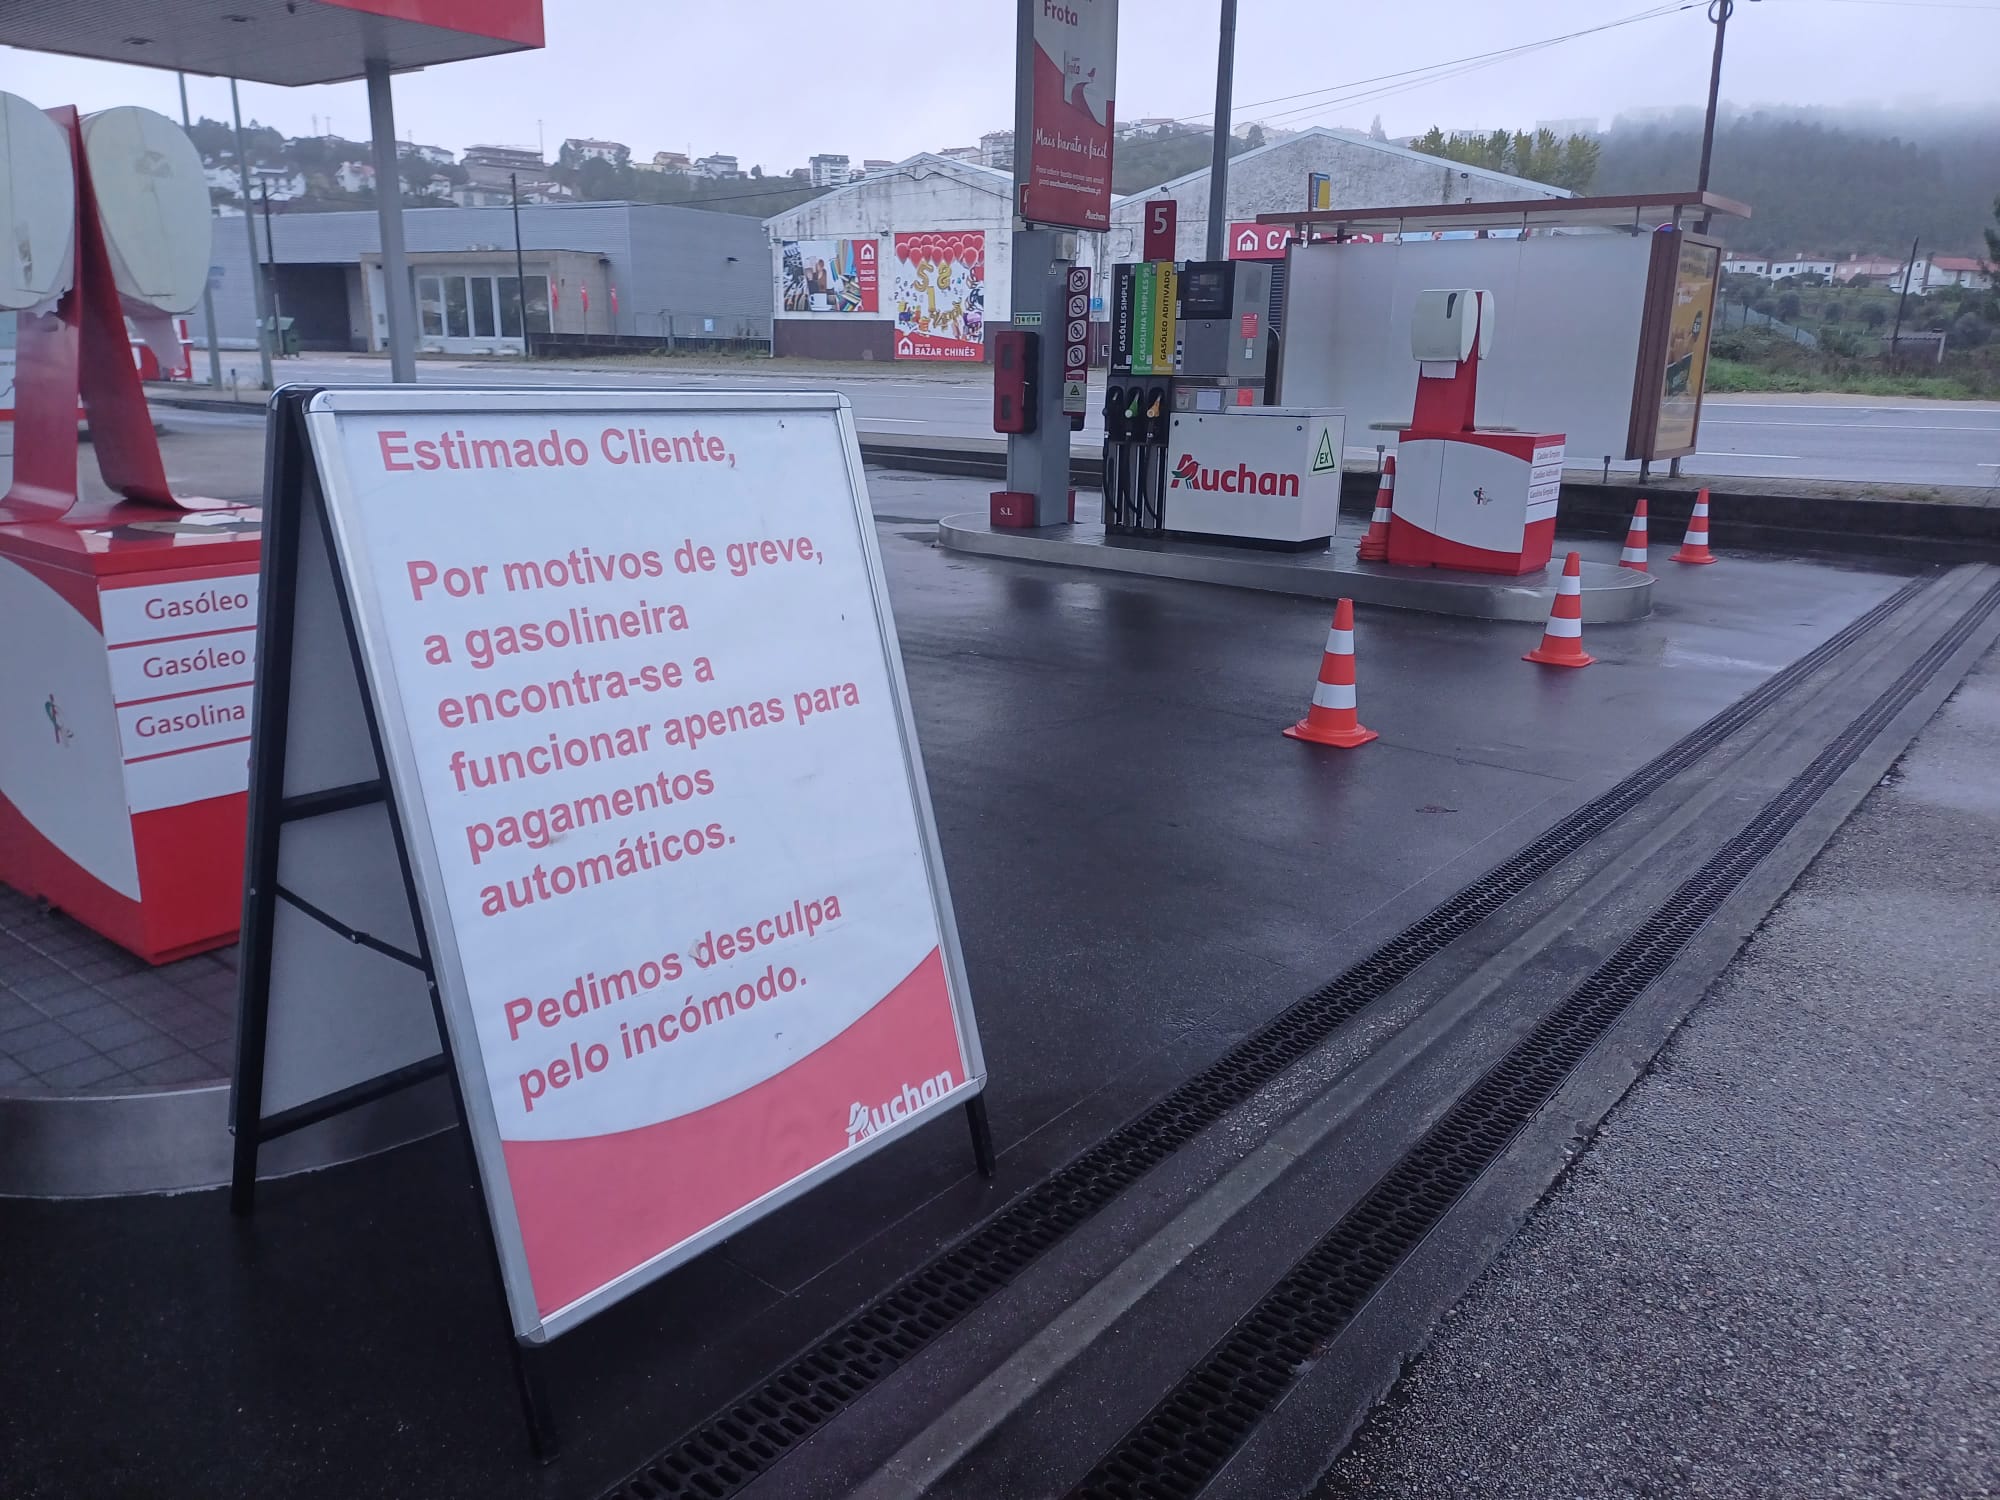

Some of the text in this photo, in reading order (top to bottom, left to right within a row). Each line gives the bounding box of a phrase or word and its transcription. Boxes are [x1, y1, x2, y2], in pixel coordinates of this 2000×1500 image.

[1044, 0, 1078, 26] Frota
[1035, 128, 1055, 148] Mais
[1058, 131, 1081, 152] barato
[1089, 137, 1107, 159] fácil
[1153, 207, 1168, 234] 5
[1118, 274, 1129, 352] GASÓLEO SIMPLES
[1141, 279, 1150, 316] SIMPLES
[1162, 270, 1171, 318] ADITIVADO
[915, 346, 976, 357] BAZAR CHINÊS
[1139, 318, 1149, 361] GASOLINA
[1159, 321, 1169, 361] GASÓLEO
[377, 428, 736, 472] Estimado Cliente,
[1319, 452, 1329, 465] EX
[1171, 453, 1300, 498] Auchan
[407, 535, 823, 602] Por motivos de greve,
[144, 590, 249, 620] Gasóleo
[424, 600, 689, 670] a gasolineira
[143, 647, 247, 679] Gasóleo
[438, 656, 715, 729] encontra-se a
[135, 704, 246, 738] Gasolina
[449, 682, 860, 792] funcionar apenas para
[465, 768, 716, 866] pagamentos
[479, 820, 737, 917] automáticos.
[503, 895, 842, 1042] Pedimos desculpa
[518, 962, 808, 1113] pelo incómodo.
[846, 1070, 954, 1147] Auchan
